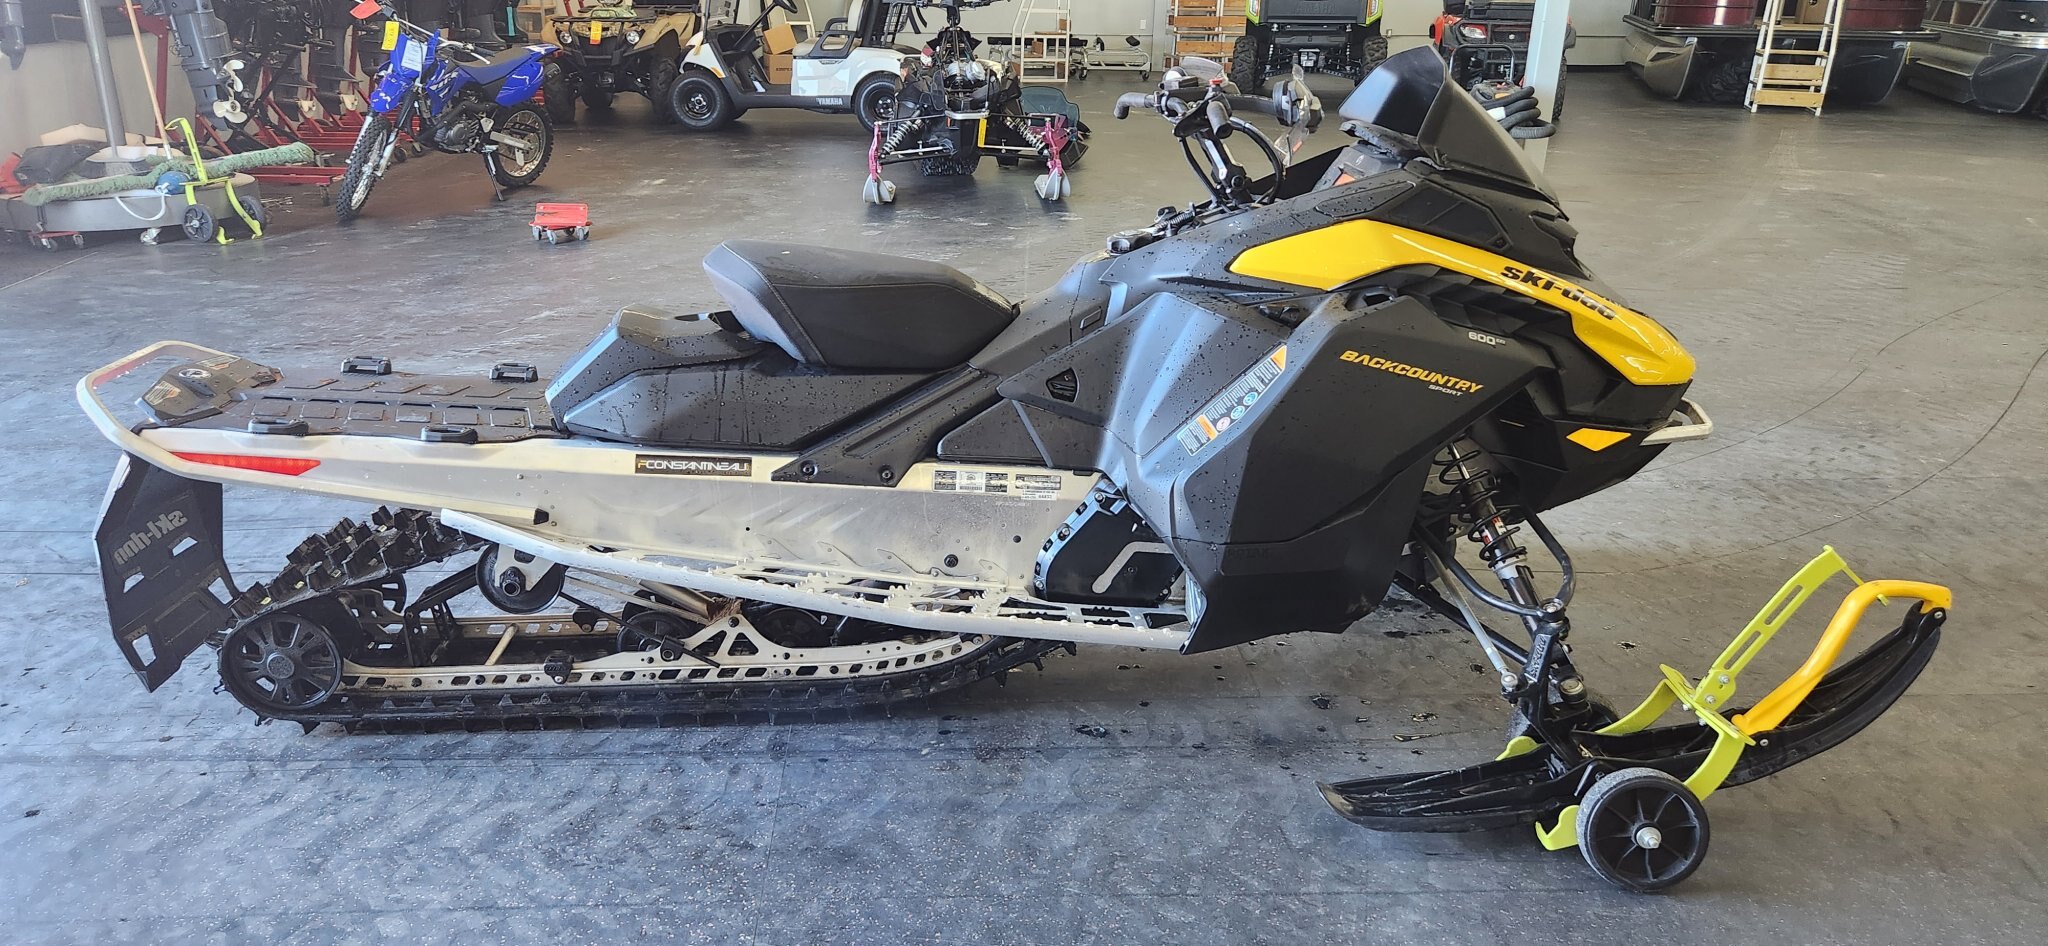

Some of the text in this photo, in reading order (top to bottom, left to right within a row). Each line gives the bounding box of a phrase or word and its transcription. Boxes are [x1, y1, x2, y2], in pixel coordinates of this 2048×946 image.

[817, 97, 843, 106] YAMAHA
[1468, 331, 1497, 346] 600
[1339, 350, 1484, 393] BACKCOUNTRY
[1428, 384, 1464, 397] SPORT
